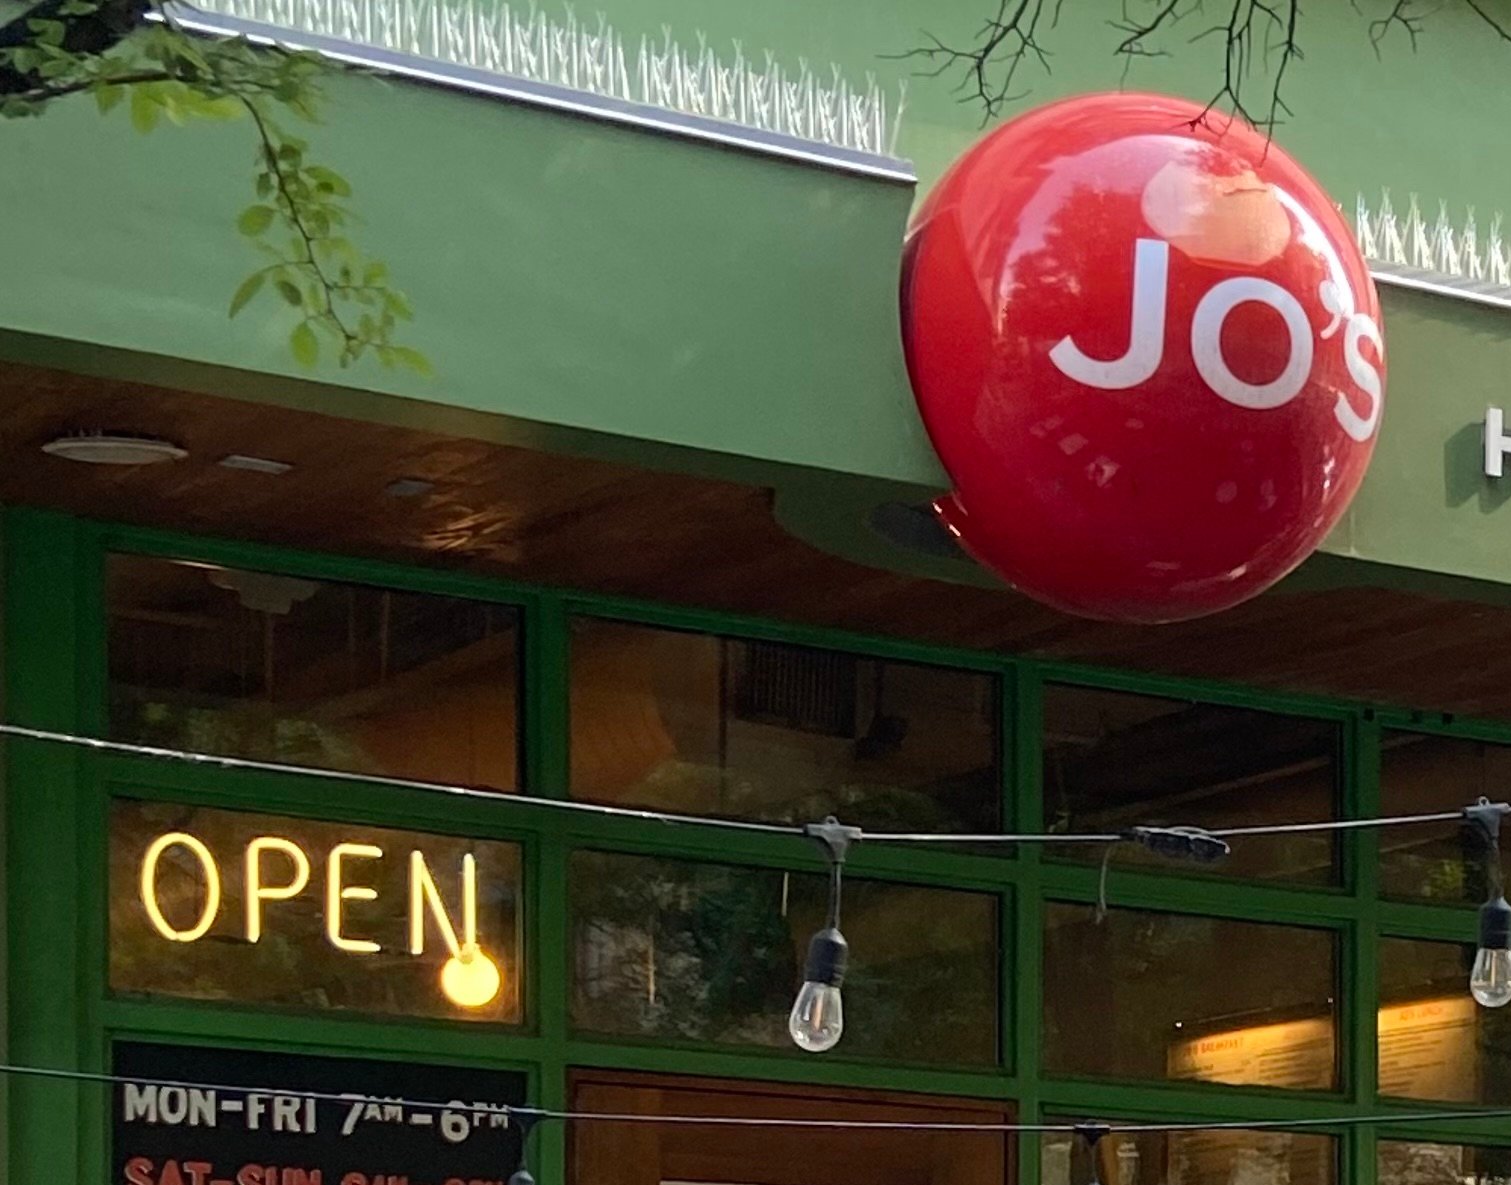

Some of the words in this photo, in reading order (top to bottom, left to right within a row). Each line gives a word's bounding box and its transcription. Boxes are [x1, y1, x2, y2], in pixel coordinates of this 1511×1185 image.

[1048, 238, 1384, 442] JO'S
[140, 831, 479, 960] OPEN
[123, 1083, 317, 1135] MON-FRI
